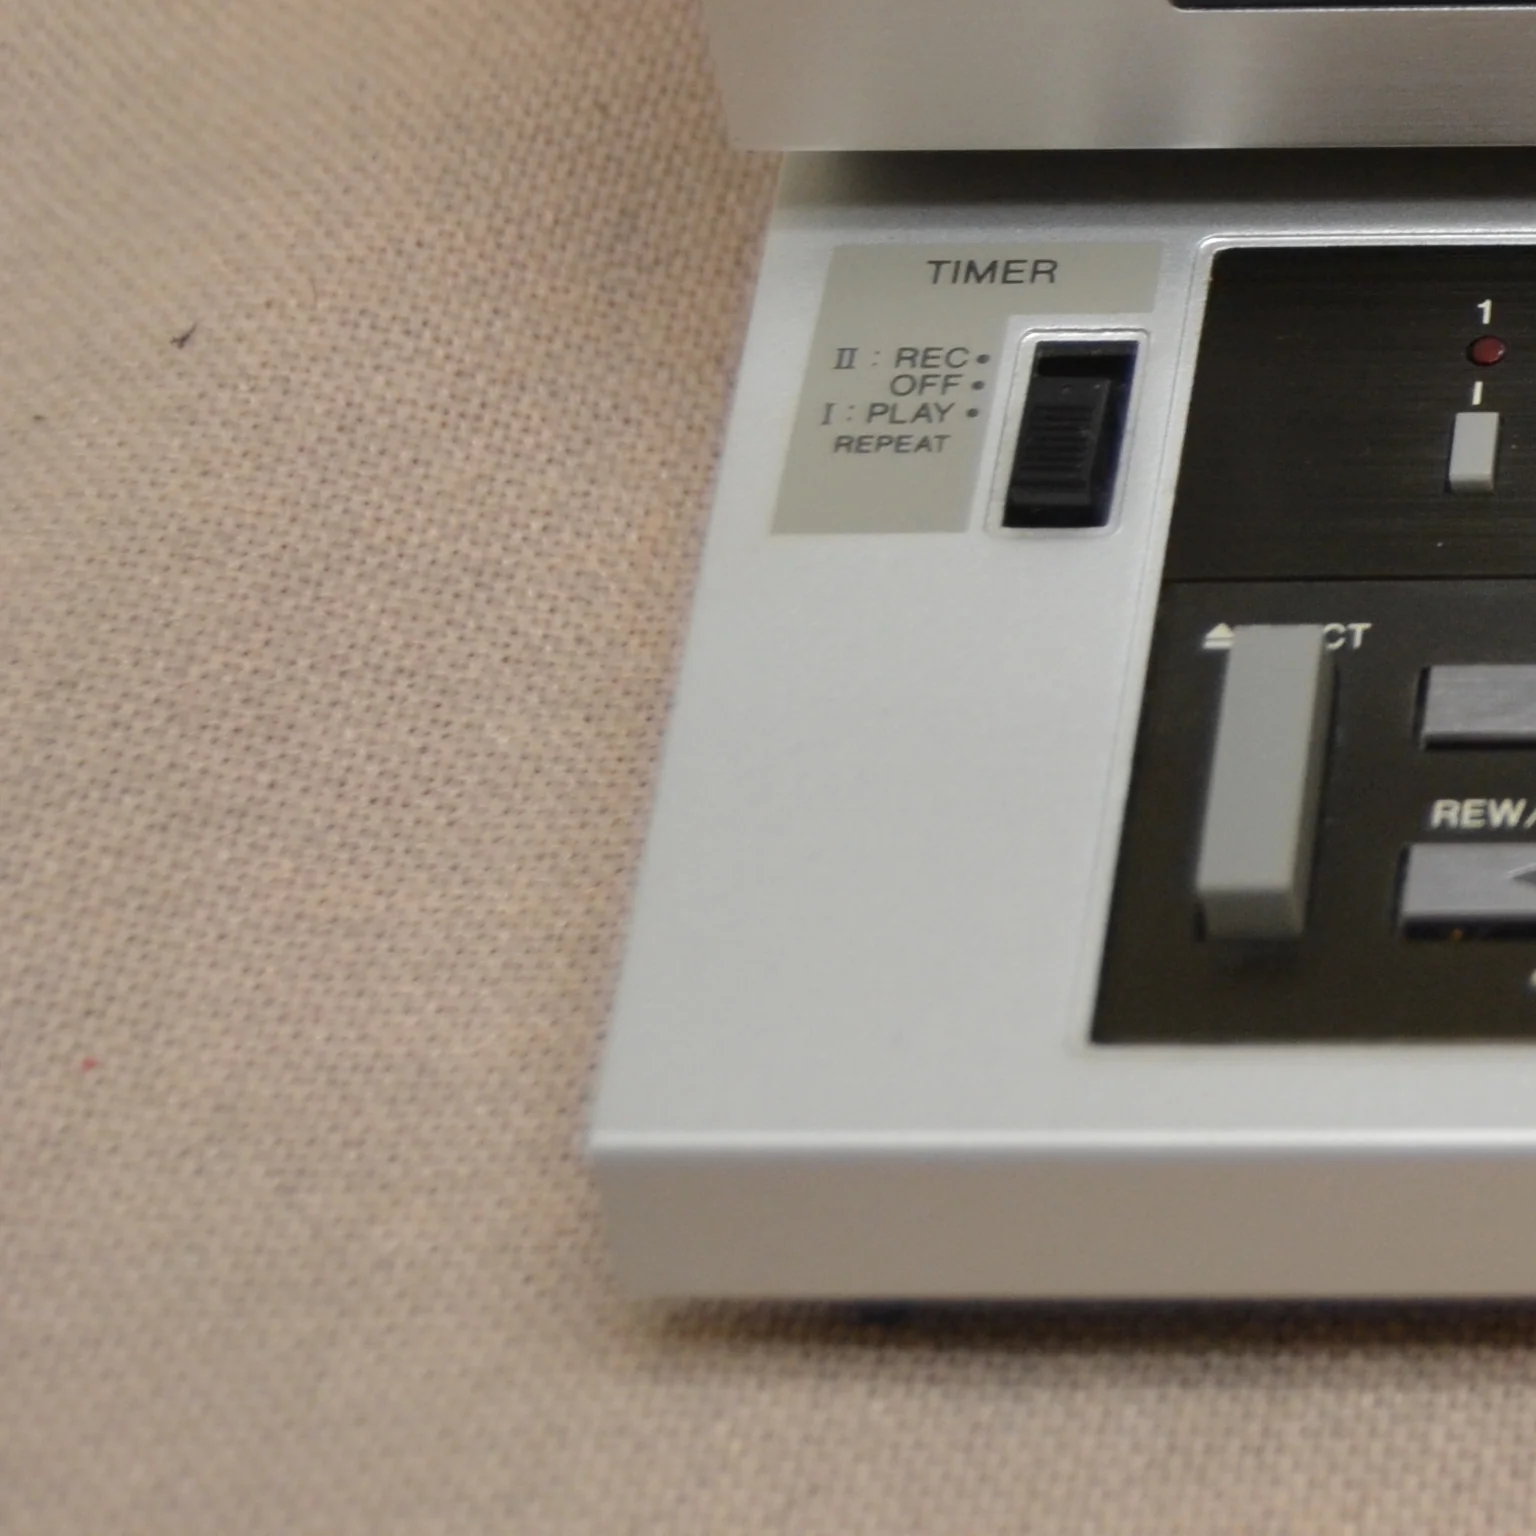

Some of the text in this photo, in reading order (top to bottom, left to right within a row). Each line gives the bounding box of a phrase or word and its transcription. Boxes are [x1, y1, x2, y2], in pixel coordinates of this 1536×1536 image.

[926, 258, 1058, 285] TIMER
[1477, 299, 1492, 325] 1
[894, 346, 970, 370] REC
[889, 373, 963, 397] OFF
[865, 402, 955, 425] PLAY
[833, 434, 950, 454] REPEAT
